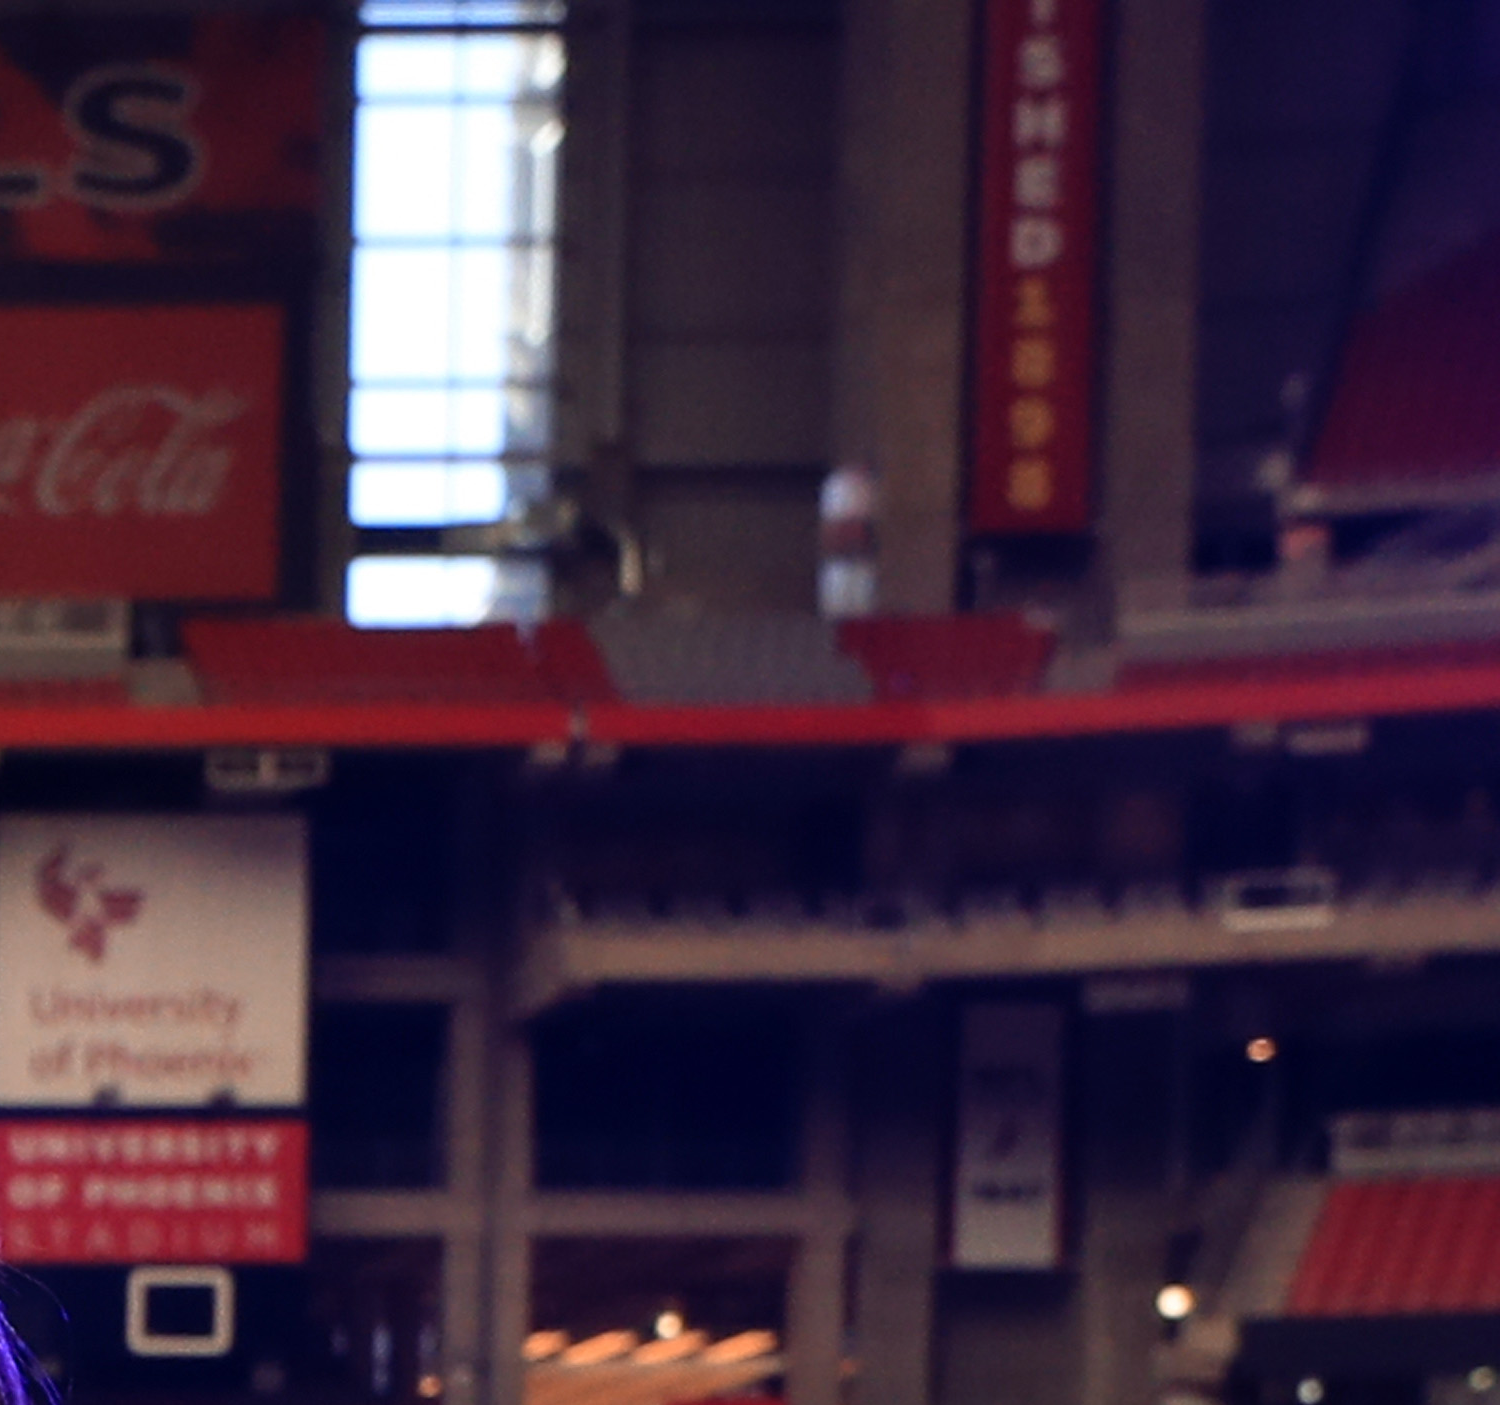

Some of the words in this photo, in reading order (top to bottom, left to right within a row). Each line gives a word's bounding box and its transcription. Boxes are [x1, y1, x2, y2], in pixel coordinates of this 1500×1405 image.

[29, 989, 240, 1045] University
[30, 1042, 73, 1078] of
[82, 1042, 252, 1079] Phoenix
[8, 1128, 279, 1164] UNIVERSITY
[7, 1174, 65, 1209] OF
[82, 1174, 279, 1209] PHOENIX
